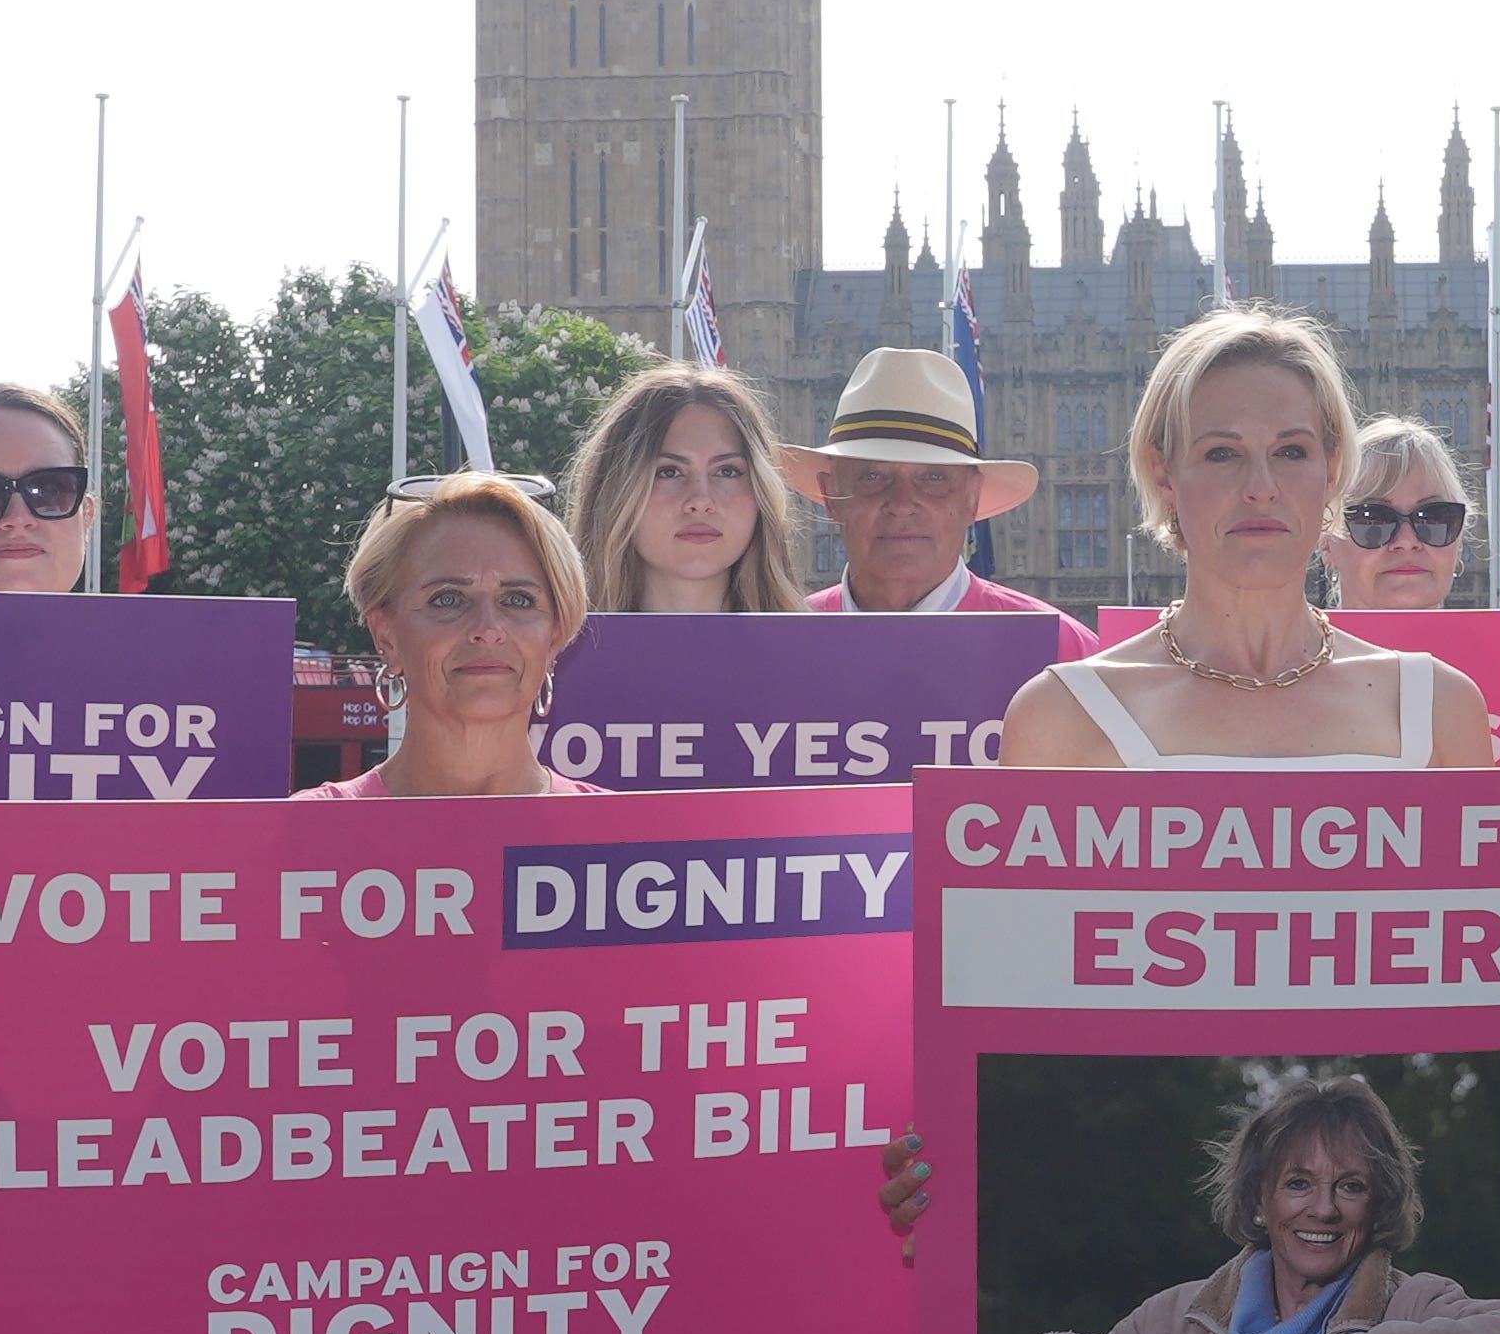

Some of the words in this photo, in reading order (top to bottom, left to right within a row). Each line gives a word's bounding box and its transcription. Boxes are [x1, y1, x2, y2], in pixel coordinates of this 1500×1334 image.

[85, 703, 216, 748] FOR
[343, 703, 361, 714] Hop
[363, 703, 376, 713] On
[343, 715, 361, 726] Hop
[363, 715, 378, 725] Off
[735, 722, 890, 776] YES
[946, 804, 1422, 869] CAMPAIGN
[281, 868, 474, 939] FOR
[517, 852, 909, 932] DIGNITY
[88, 1019, 353, 1091] VOTE
[396, 1011, 584, 1083] FOR
[625, 998, 807, 1071] THE
[695, 1083, 890, 1158] BILL
[208, 1250, 528, 1304] CAMPAIGN
[557, 1241, 670, 1285] FOR
